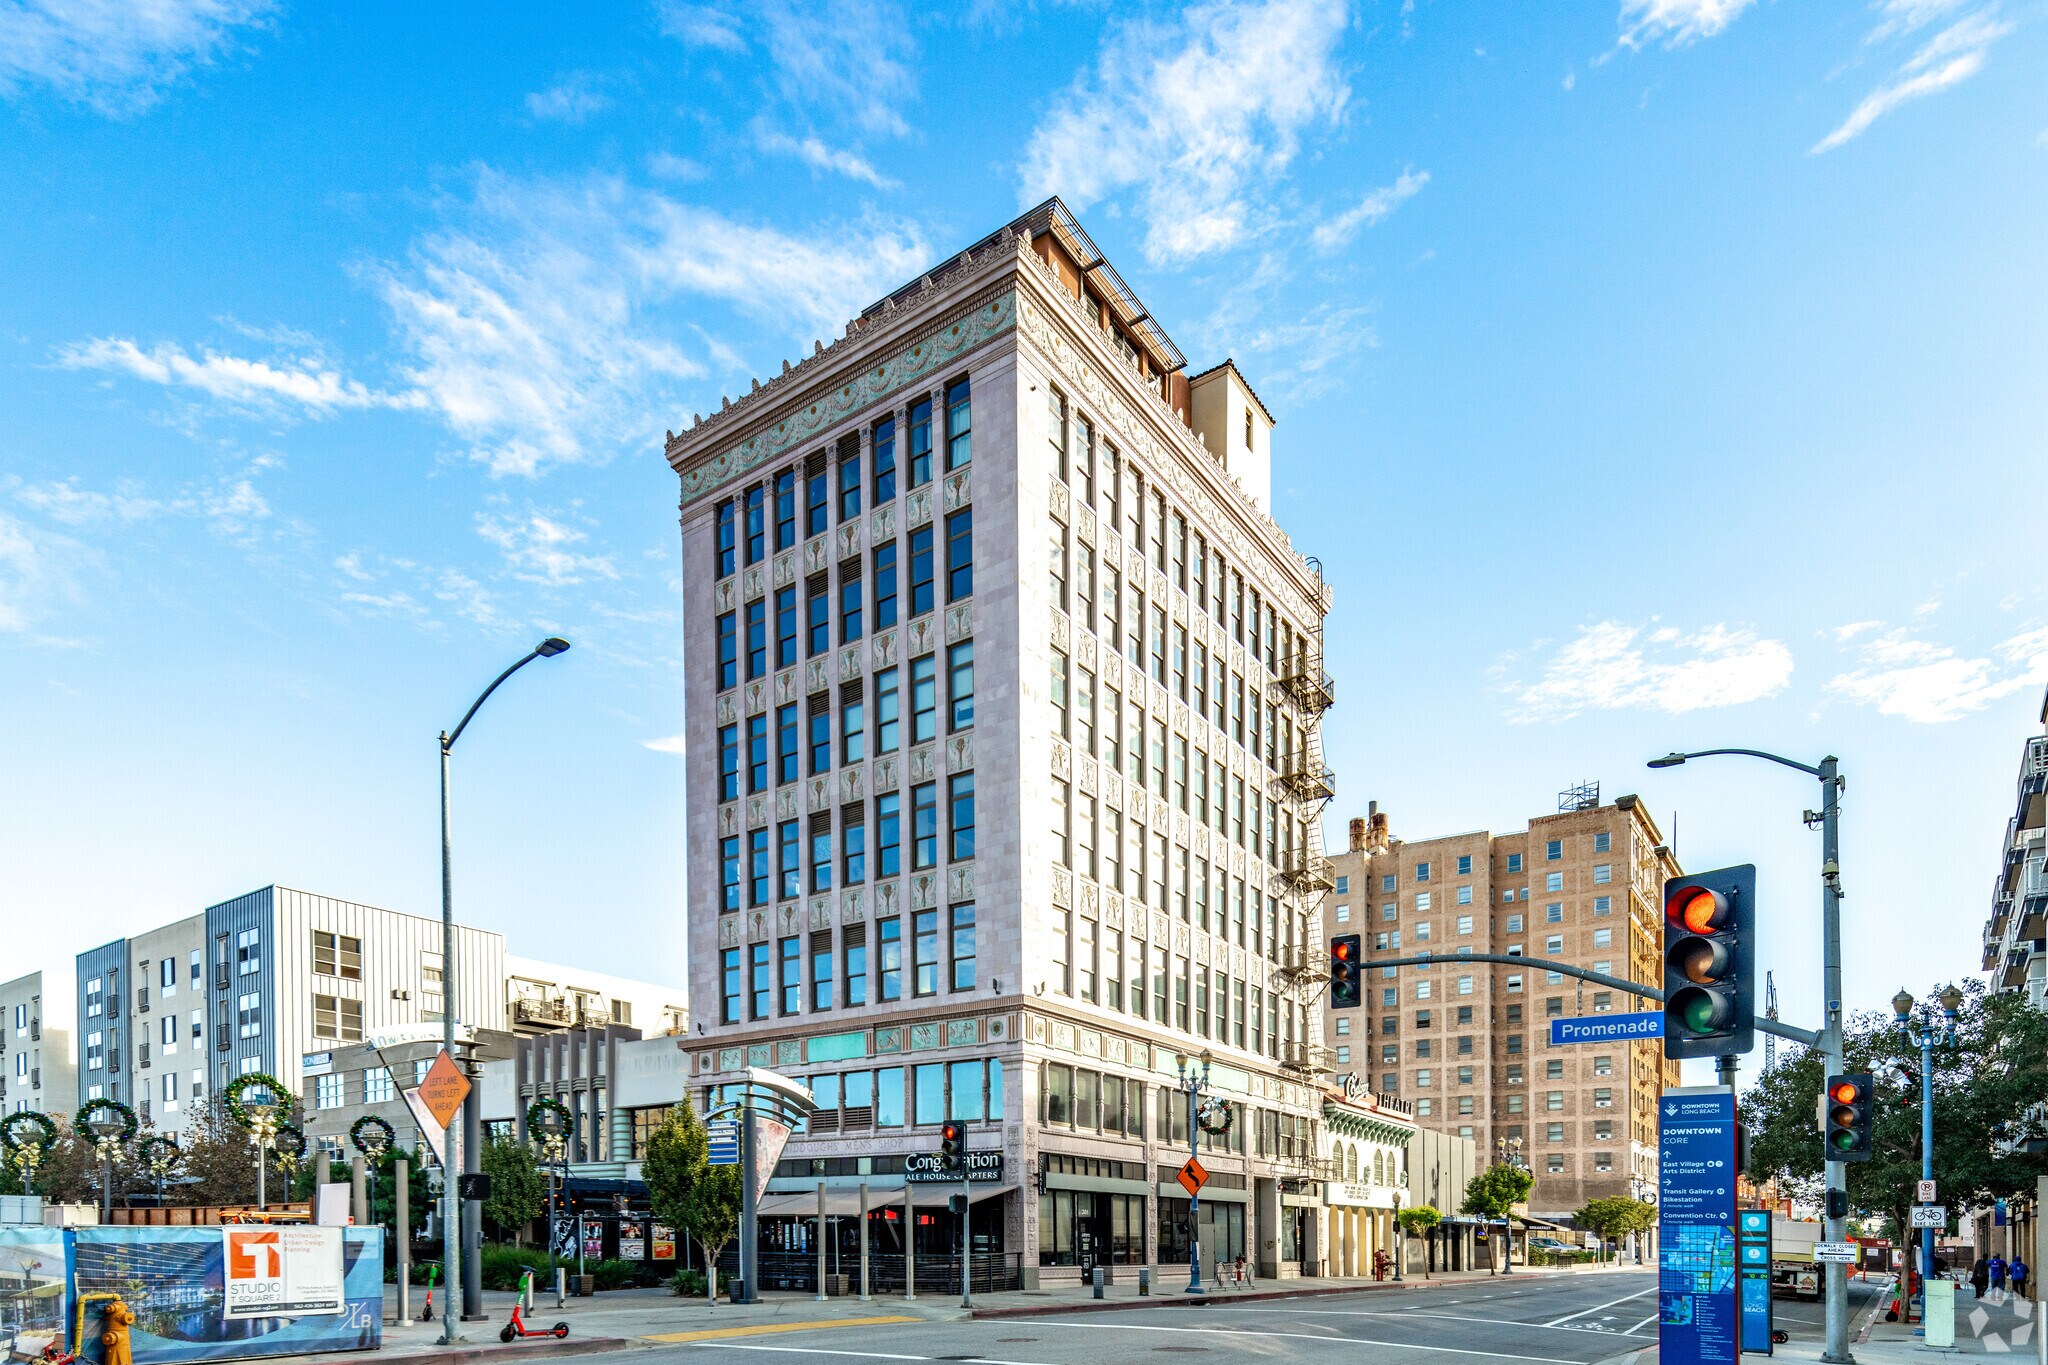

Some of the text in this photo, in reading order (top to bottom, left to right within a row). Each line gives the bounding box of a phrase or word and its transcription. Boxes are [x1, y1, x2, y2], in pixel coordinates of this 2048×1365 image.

[1562, 1019, 1658, 1038] Promenade
[429, 1075, 458, 1087] LEFT LANE
[427, 1089, 460, 1099] TURNS LEFT
[434, 1102, 452, 1111] AHEAD
[1376, 1092, 1415, 1116] THEATRE
[1663, 1127, 1722, 1135] DOWNTOWN
[880, 1139, 903, 1149] SHOP
[905, 1152, 999, 1172] Congtion
[1688, 1188, 1715, 1196] Gallery
[304, 1239, 326, 1247] Design
[230, 1282, 281, 1295] STUDIO
[239, 1294, 276, 1303] SQUARE
